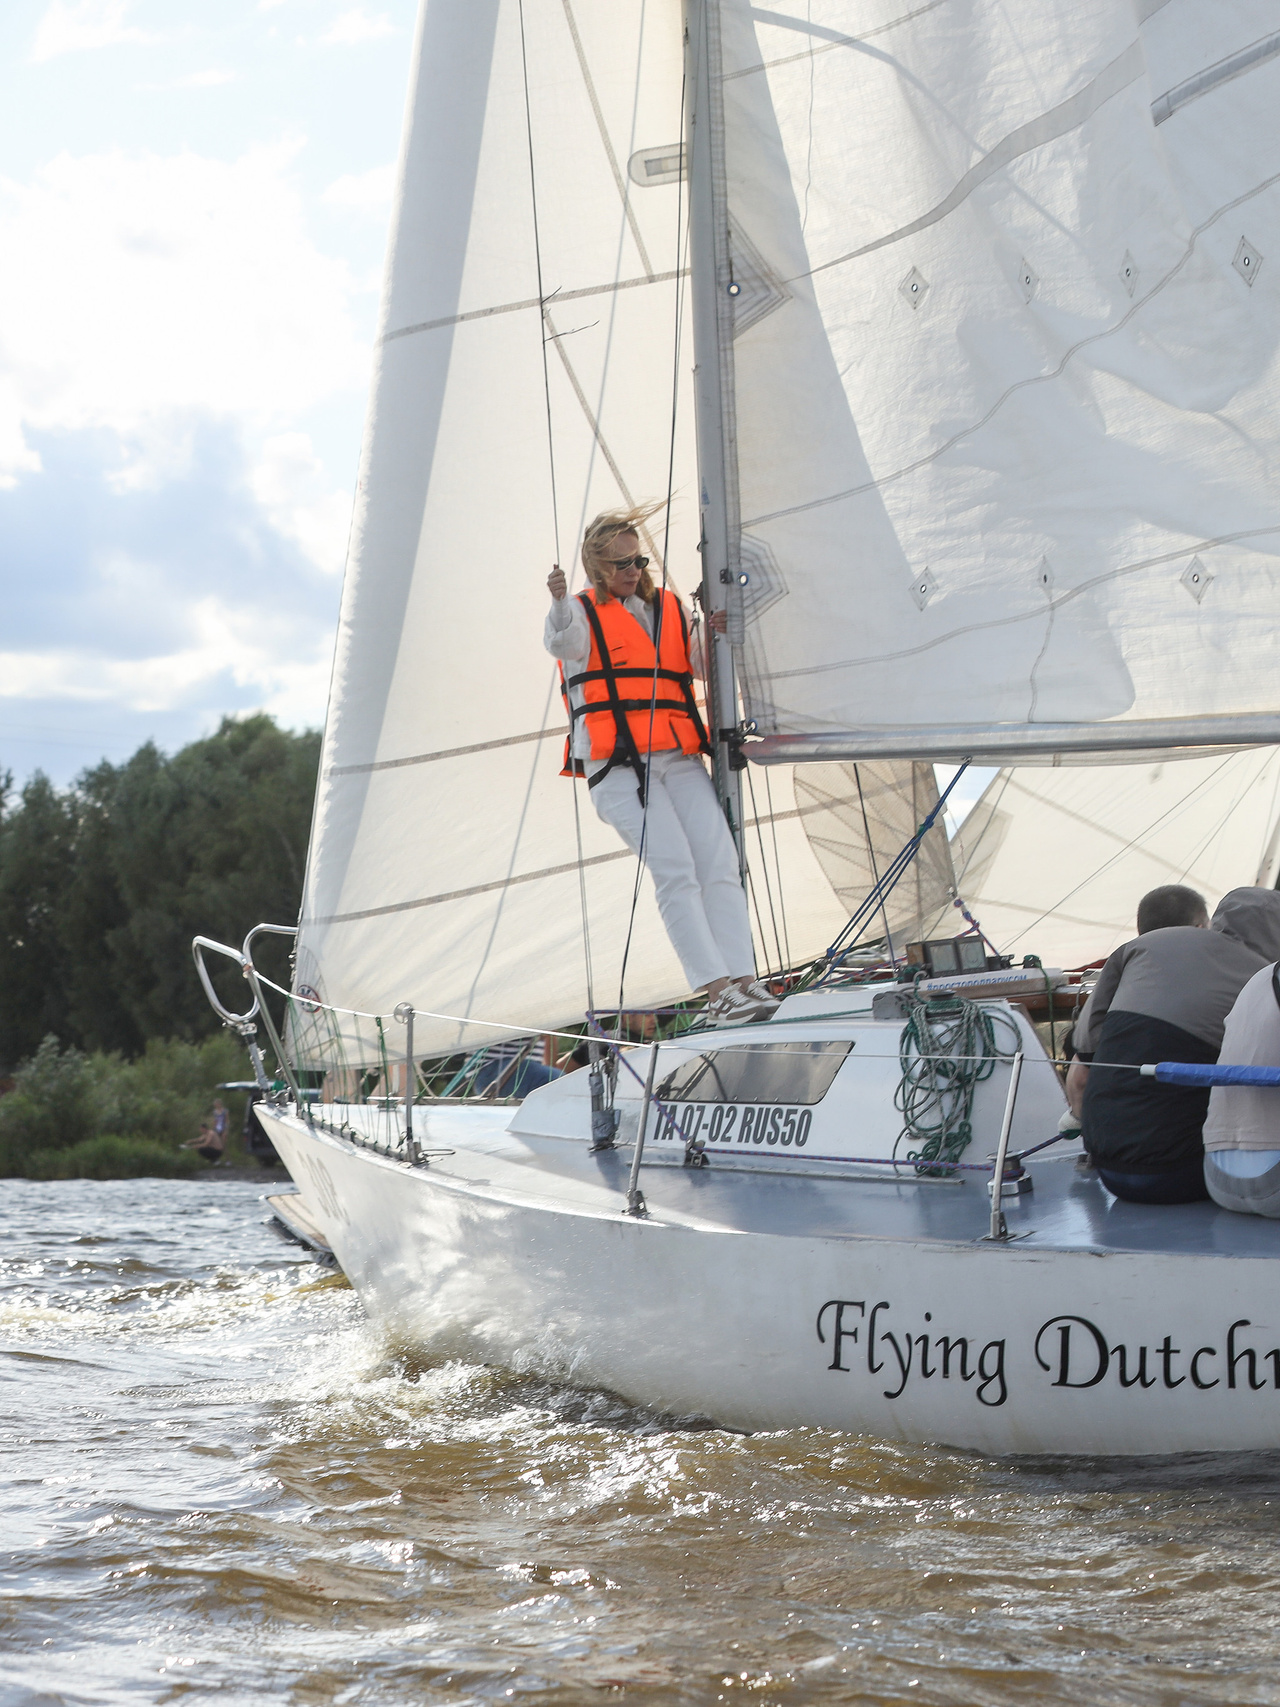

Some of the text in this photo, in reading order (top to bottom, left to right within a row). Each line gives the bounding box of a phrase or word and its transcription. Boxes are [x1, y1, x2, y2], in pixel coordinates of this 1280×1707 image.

[680, 1104, 738, 1143] 07-02
[737, 1107, 813, 1147] RUS50
[816, 1300, 1008, 1407] Flying
